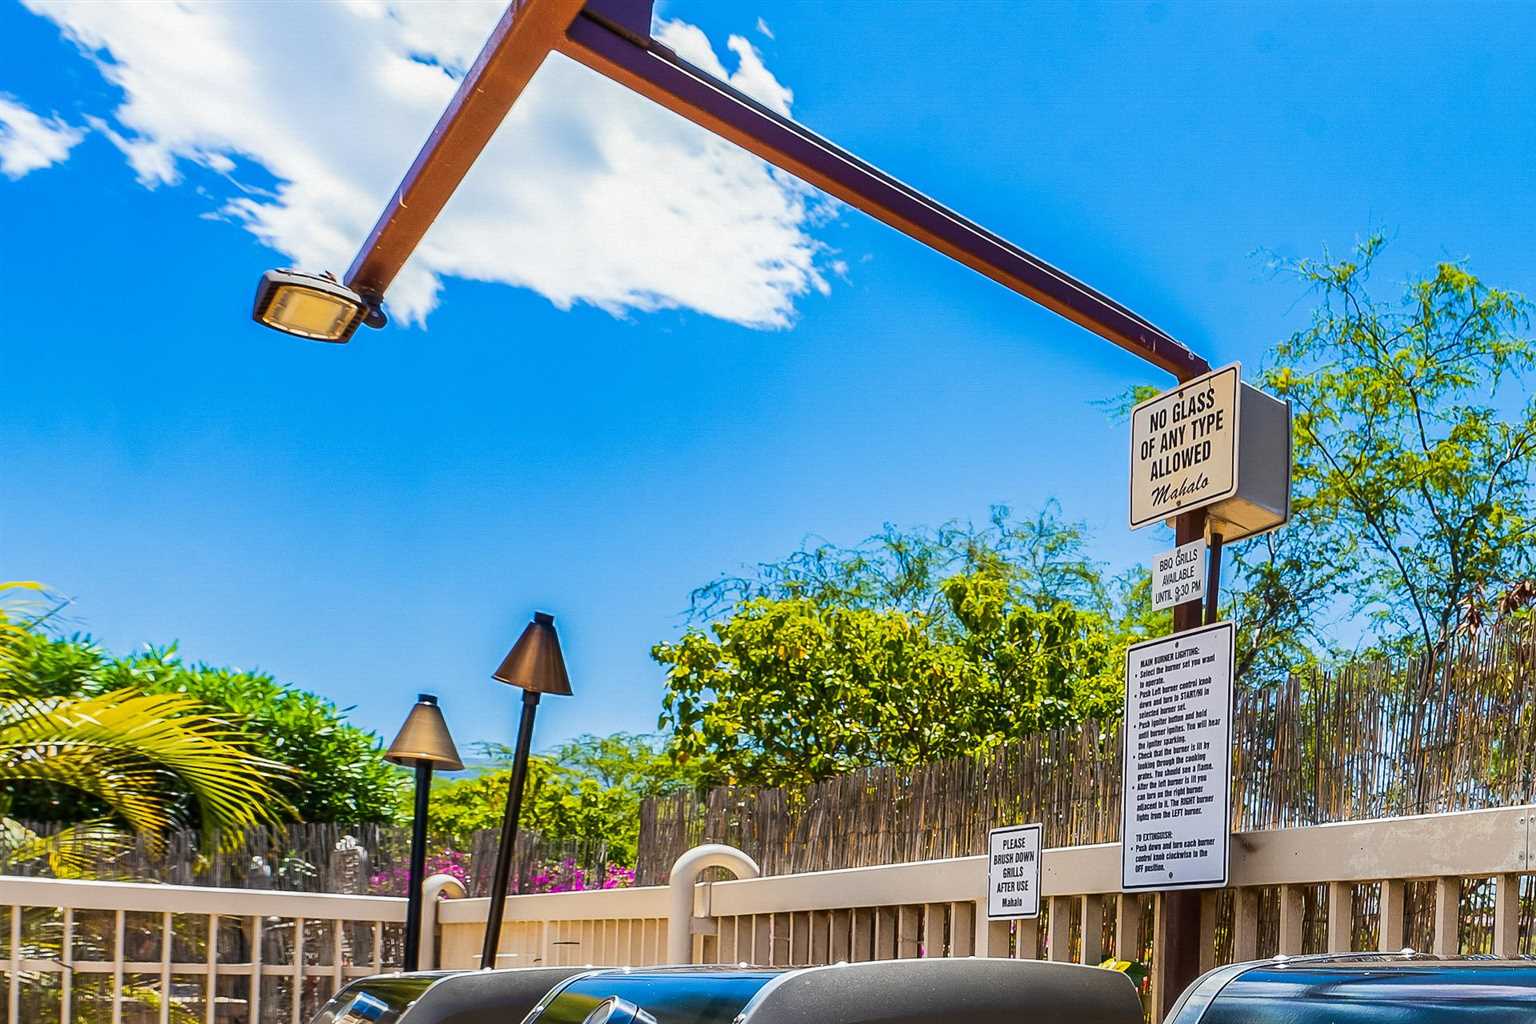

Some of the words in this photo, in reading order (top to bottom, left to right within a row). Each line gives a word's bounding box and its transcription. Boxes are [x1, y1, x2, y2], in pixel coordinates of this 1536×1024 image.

[1150, 409, 1167, 433] NO
[1173, 388, 1214, 423] GLASS
[1141, 438, 1155, 460] OF
[1160, 425, 1186, 453] ANY
[1191, 410, 1223, 440] TYPE
[1151, 440, 1210, 481] ALLOWED
[1152, 473, 1208, 507] Mahalo
[1160, 558, 1173, 571] BBQ
[1176, 549, 1197, 566] GRILLS
[1162, 566, 1194, 586] AVAILABLE
[1156, 590, 1172, 604] UNTIL
[1192, 579, 1200, 593] PM
[1003, 837, 1025, 850] PLEASE
[994, 854, 1013, 865] BRUSH
[1015, 851, 1034, 862] DOWN
[1003, 867, 1023, 878] GRILLS
[997, 882, 1015, 893] AFTER
[1017, 881, 1028, 891] USE
[1002, 898, 1022, 907] Mahalo
